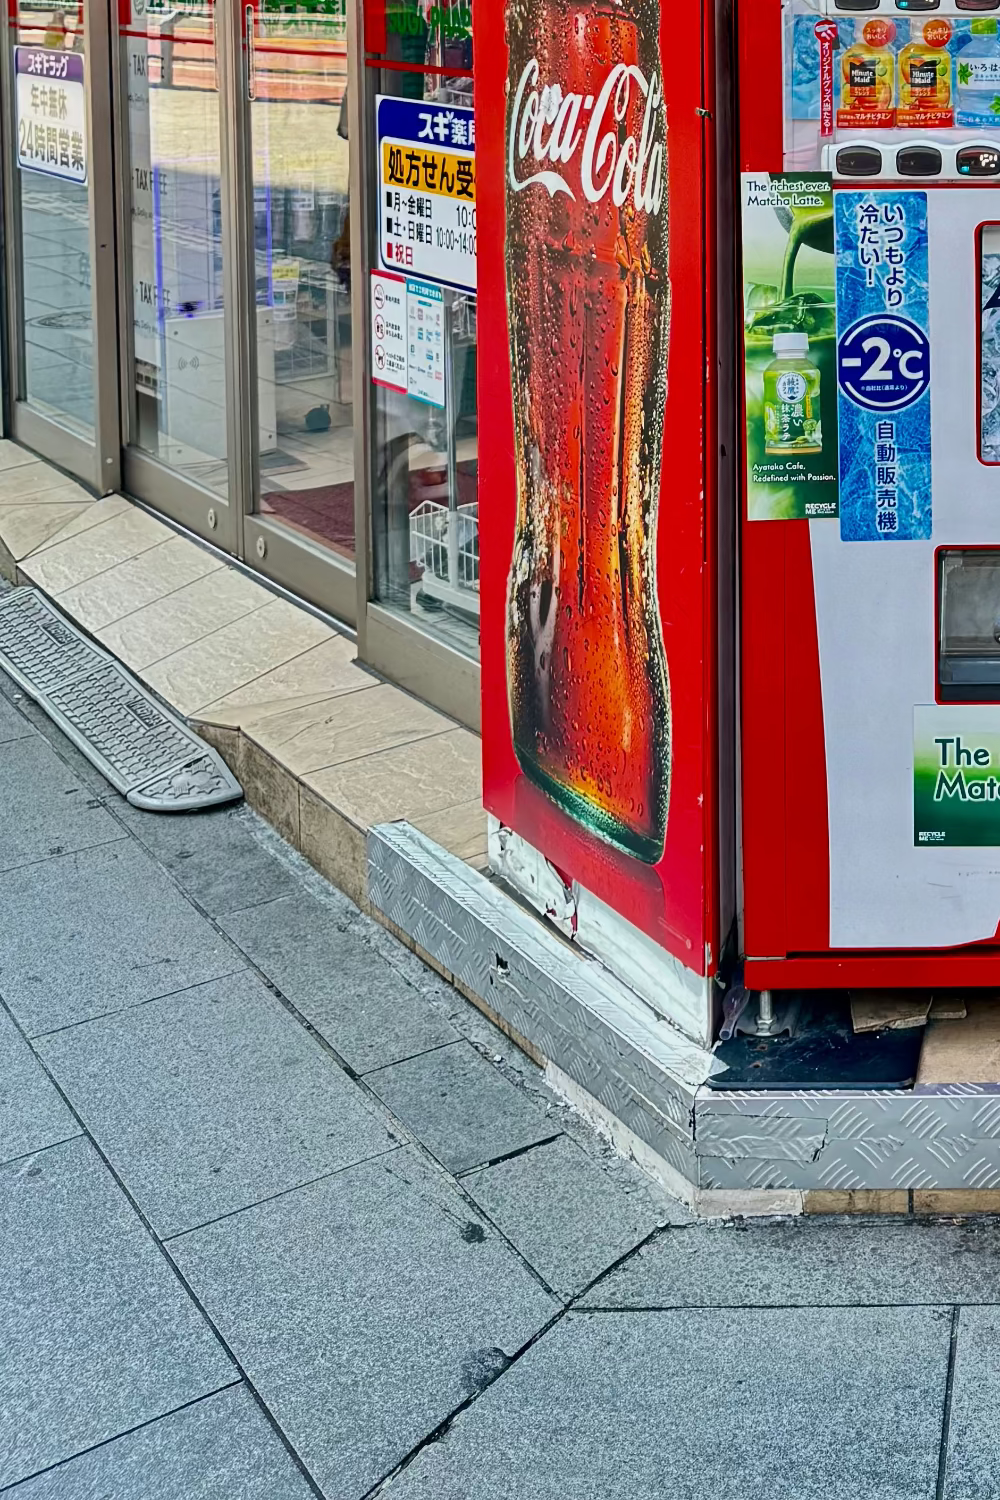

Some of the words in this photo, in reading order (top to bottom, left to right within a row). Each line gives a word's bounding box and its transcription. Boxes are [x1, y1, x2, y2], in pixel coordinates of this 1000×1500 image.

[28, 53, 69, 78] スギドラッグ
[851, 69, 873, 77] Minute
[31, 83, 68, 120] 年中無休
[822, 41, 831, 135] オリジナルグッズ当たる!
[19, 118, 84, 171] 24時間営業
[509, 58, 664, 215] Coca-Cola
[135, 168, 148, 191] TAX
[388, 146, 477, 199] 処方せん受
[746, 180, 767, 192] The
[770, 179, 803, 191] richest
[805, 181, 830, 191] ever.
[747, 194, 790, 206] Matcha
[793, 194, 824, 206] Latte.
[395, 243, 414, 266] 祝日
[858, 203, 881, 286] 冷たい!
[884, 204, 905, 308] いつもより
[139, 281, 153, 304] TAX
[781, 403, 791, 441] 抹茶ラテ
[791, 403, 804, 427] 濃い
[752, 463, 784, 473] Ayataka
[753, 474, 789, 483] Redefined
[790, 473, 806, 482] with
[807, 473, 837, 482] Passion.
[877, 421, 898, 531] 自動販売機
[934, 737, 990, 767] The
